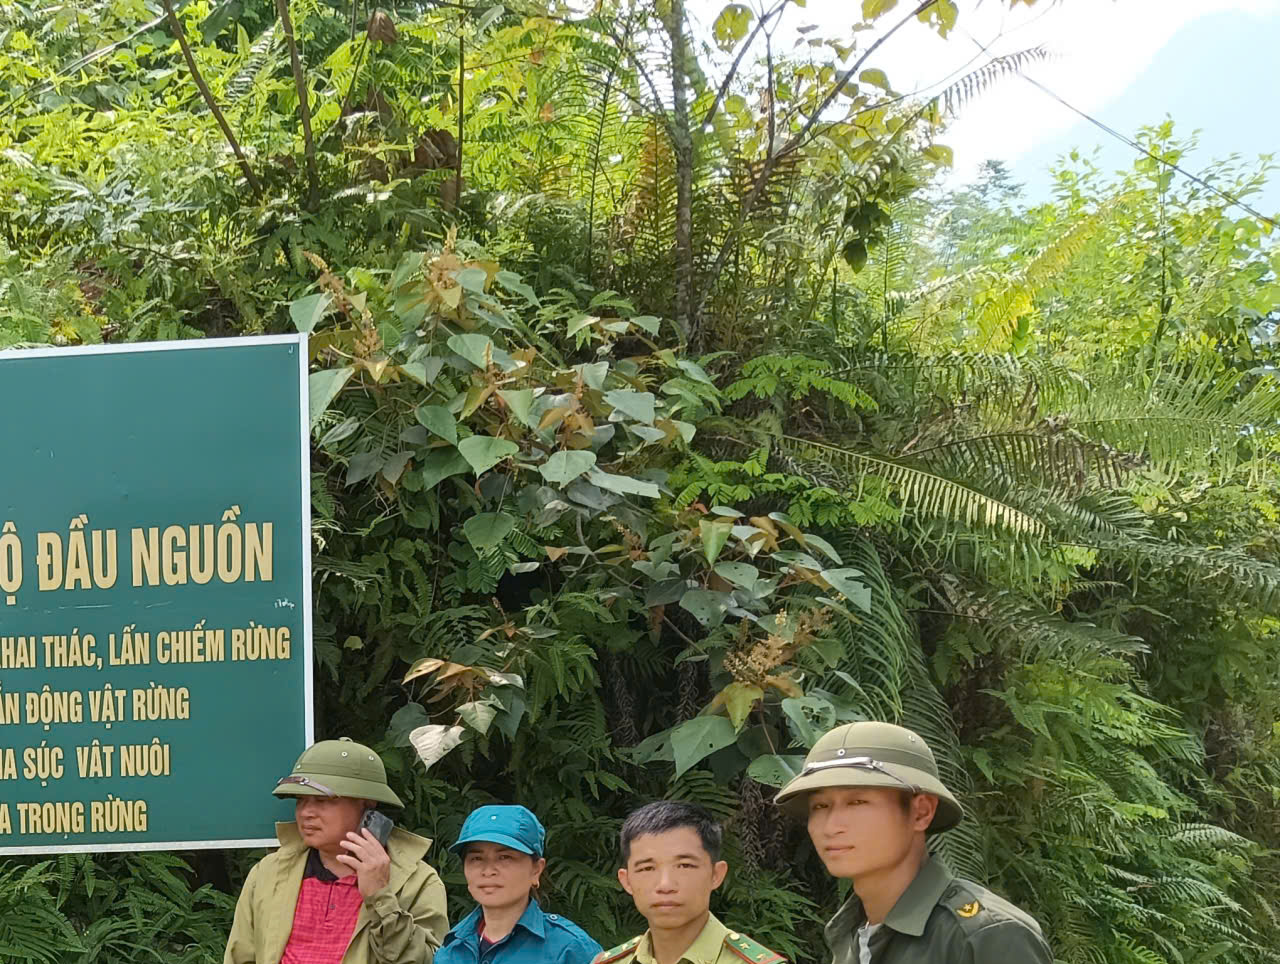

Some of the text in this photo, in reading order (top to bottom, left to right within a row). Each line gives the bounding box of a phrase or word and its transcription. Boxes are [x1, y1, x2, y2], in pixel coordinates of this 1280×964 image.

[36, 514, 118, 591] ĐẦU
[131, 506, 273, 587] NGUỒN
[42, 629, 103, 668] THÁC,
[108, 626, 150, 665] LẤN
[156, 623, 225, 664] CHIẾM
[231, 623, 291, 661] RỪNG
[26, 684, 83, 729] ĐỘNG
[88, 684, 127, 729] VẬT
[132, 683, 190, 721] RỪNG
[120, 738, 170, 777] NUÔI
[90, 794, 147, 833] RỪNG
